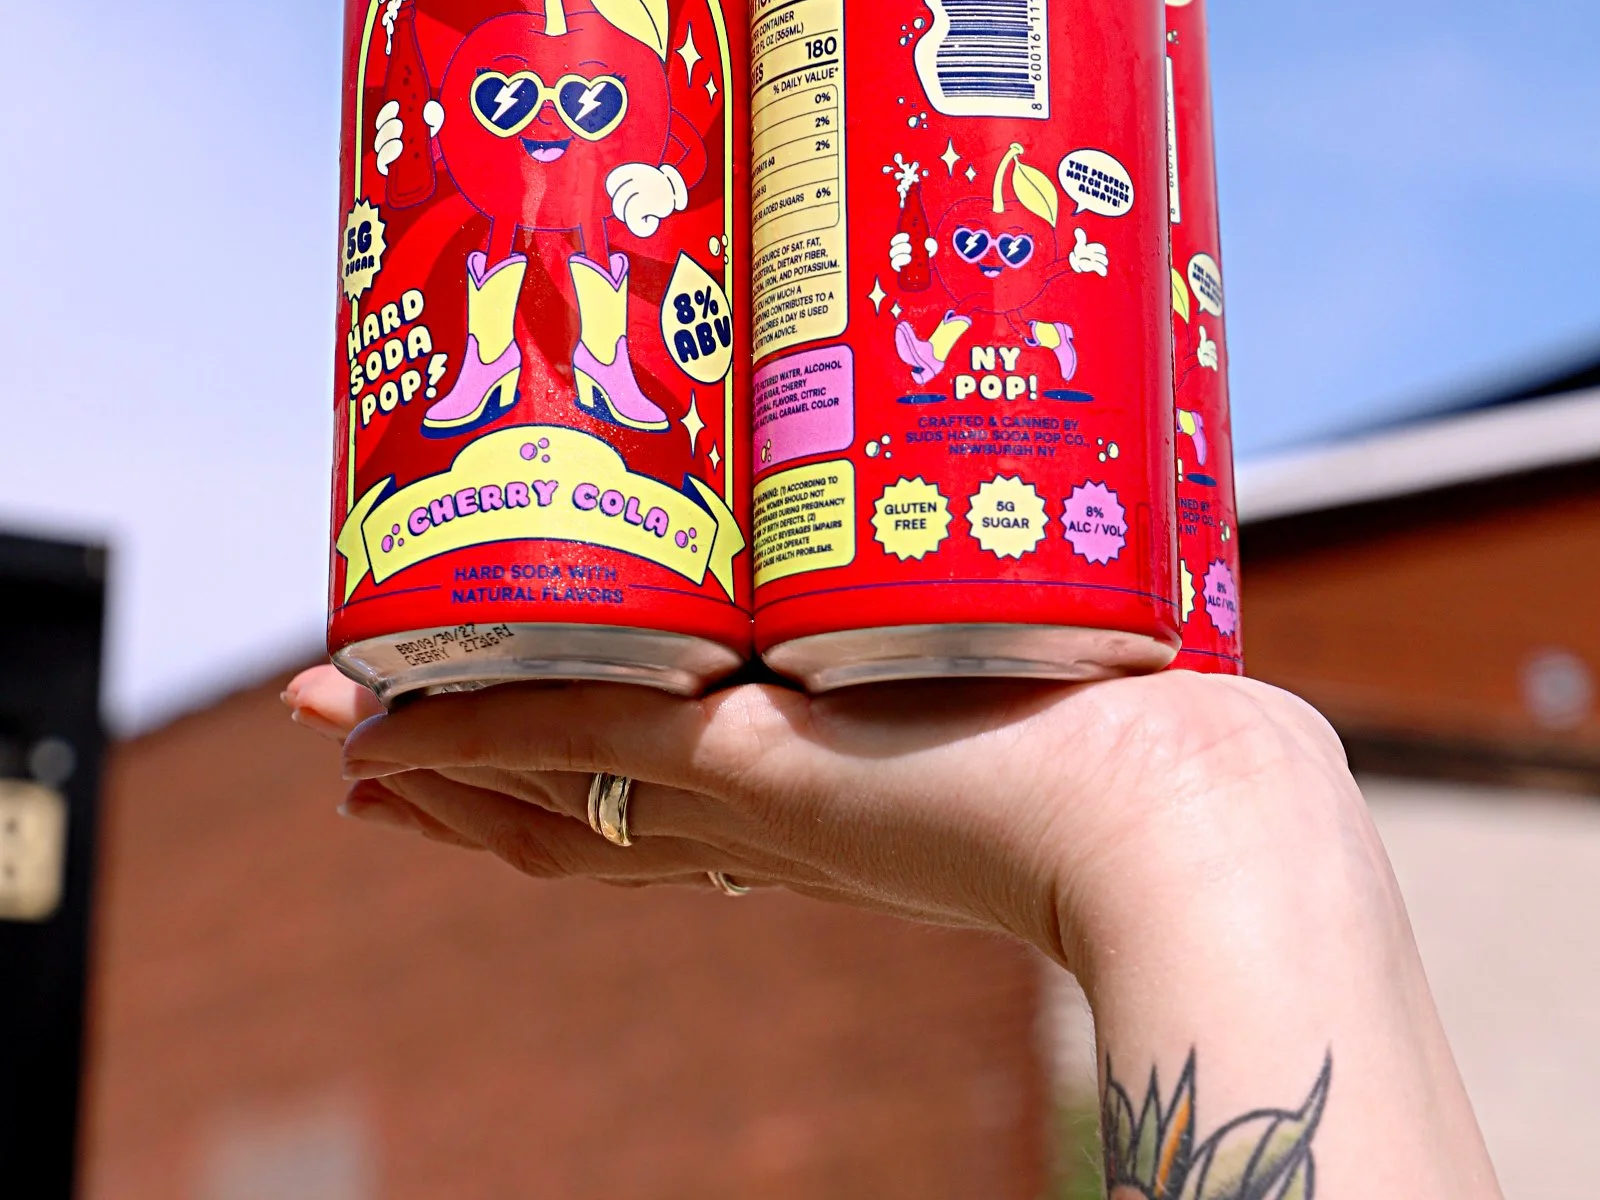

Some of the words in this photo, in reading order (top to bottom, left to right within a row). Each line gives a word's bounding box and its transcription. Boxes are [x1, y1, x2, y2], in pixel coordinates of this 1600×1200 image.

[760, 11, 794, 36] CONTAINER
[806, 37, 837, 59] 180
[1030, 32, 1042, 81] 60016
[774, 84, 779, 93] %
[781, 76, 802, 90] DAILY
[815, 92, 831, 104] 0%
[1031, 103, 1042, 111] 8
[815, 116, 830, 127] 2%
[815, 139, 831, 151] 2%
[1068, 160, 1089, 174] THE
[1091, 169, 1129, 193] PERFECT
[1066, 169, 1101, 189] MATCH
[1104, 184, 1129, 203] SINCE
[779, 193, 804, 212] SUGARS
[815, 187, 831, 198] 6%
[1078, 184, 1121, 208] ALWAYS!
[346, 220, 372, 261] 5G
[782, 245, 789, 255] OF
[345, 254, 375, 277] SUGAR
[777, 258, 803, 270] DIETARY
[779, 271, 792, 280] AND
[777, 288, 795, 300] MUCH
[796, 286, 802, 294] A
[673, 285, 719, 325] 8%
[771, 295, 813, 316] CONTRIBUTES
[815, 293, 826, 302] TO
[828, 291, 834, 299] A
[780, 316, 784, 325] A
[785, 311, 798, 323] DAY
[800, 310, 806, 319] IS
[807, 305, 829, 317] USED
[347, 288, 425, 361] HARD
[674, 315, 731, 363] ABV
[350, 325, 433, 397] SODA
[971, 346, 1021, 371] NY
[804, 360, 842, 375] ALCOHOL
[361, 353, 448, 428] POP!
[781, 379, 808, 393] CHERRY
[801, 387, 827, 399] CITRIC
[953, 374, 1038, 400] POP!
[779, 403, 809, 418] CARAMEL
[811, 398, 839, 409] COLOR
[918, 416, 984, 429] CRAFTED
[988, 416, 997, 427] &
[1001, 417, 1060, 430] CANNED
[1063, 419, 1080, 431] BY
[906, 431, 943, 443] SUDS
[948, 429, 990, 441] HARD
[992, 430, 1030, 442] SODA
[1034, 432, 1061, 443] POP
[949, 444, 1033, 456] NEWBURGH
[1038, 445, 1056, 457] NY
[787, 478, 826, 493] ACCORDING
[828, 476, 838, 484] TO
[784, 493, 808, 504] SHOULD
[810, 489, 825, 498] NOT
[407, 480, 559, 536] CHERRY
[572, 483, 669, 537] COLA
[779, 505, 800, 517] DURING
[801, 497, 845, 511] PREGNANCY
[884, 502, 937, 515] GLUTEN
[996, 501, 1015, 512] 5G
[1086, 506, 1104, 518] 8%
[894, 519, 927, 530] FREE
[982, 517, 1030, 529] SUGAR
[1182, 512, 1200, 522] POP
[778, 525, 811, 539] BEVERAGES
[813, 520, 842, 531] IMPAIRS
[1068, 523, 1091, 533] ALC
[1103, 525, 1123, 537] VOL
[1185, 525, 1198, 535] NY
[784, 536, 810, 548] OPERATE
[776, 551, 795, 564] HEALTH
[454, 564, 505, 581] HARD
[510, 563, 561, 580] SODA
[566, 564, 617, 581] WITH
[452, 587, 537, 604] NATURAL
[541, 586, 624, 604] FLAVORS
[1217, 582, 1227, 594] 8%
[1207, 595, 1221, 606] ALC
[404, 647, 450, 666] CHERRY
